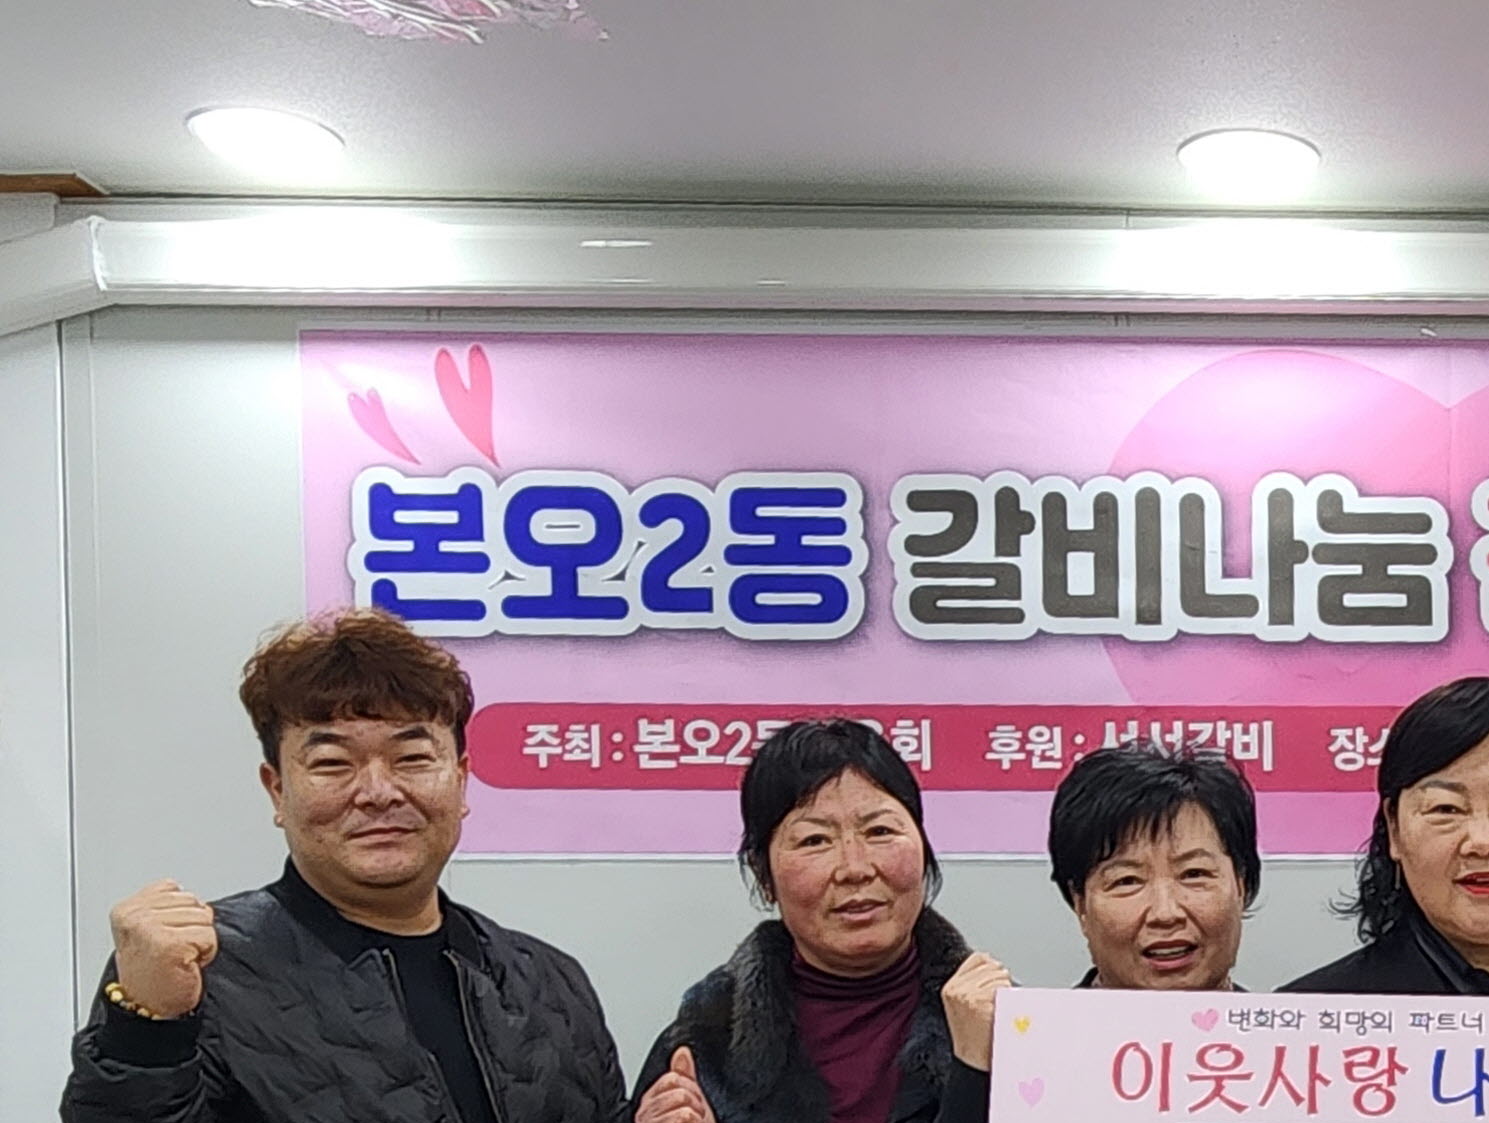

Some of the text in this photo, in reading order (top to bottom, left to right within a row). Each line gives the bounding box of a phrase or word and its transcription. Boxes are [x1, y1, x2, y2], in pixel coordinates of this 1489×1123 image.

[362, 481, 854, 625] 본오2동
[902, 483, 1441, 628] 갈비나눔
[1227, 1008, 1306, 1033] 변화와
[1317, 1010, 1394, 1036] 희망의
[1408, 1011, 1485, 1034] 파트너
[1110, 1040, 1409, 1117] 이웃사랑
